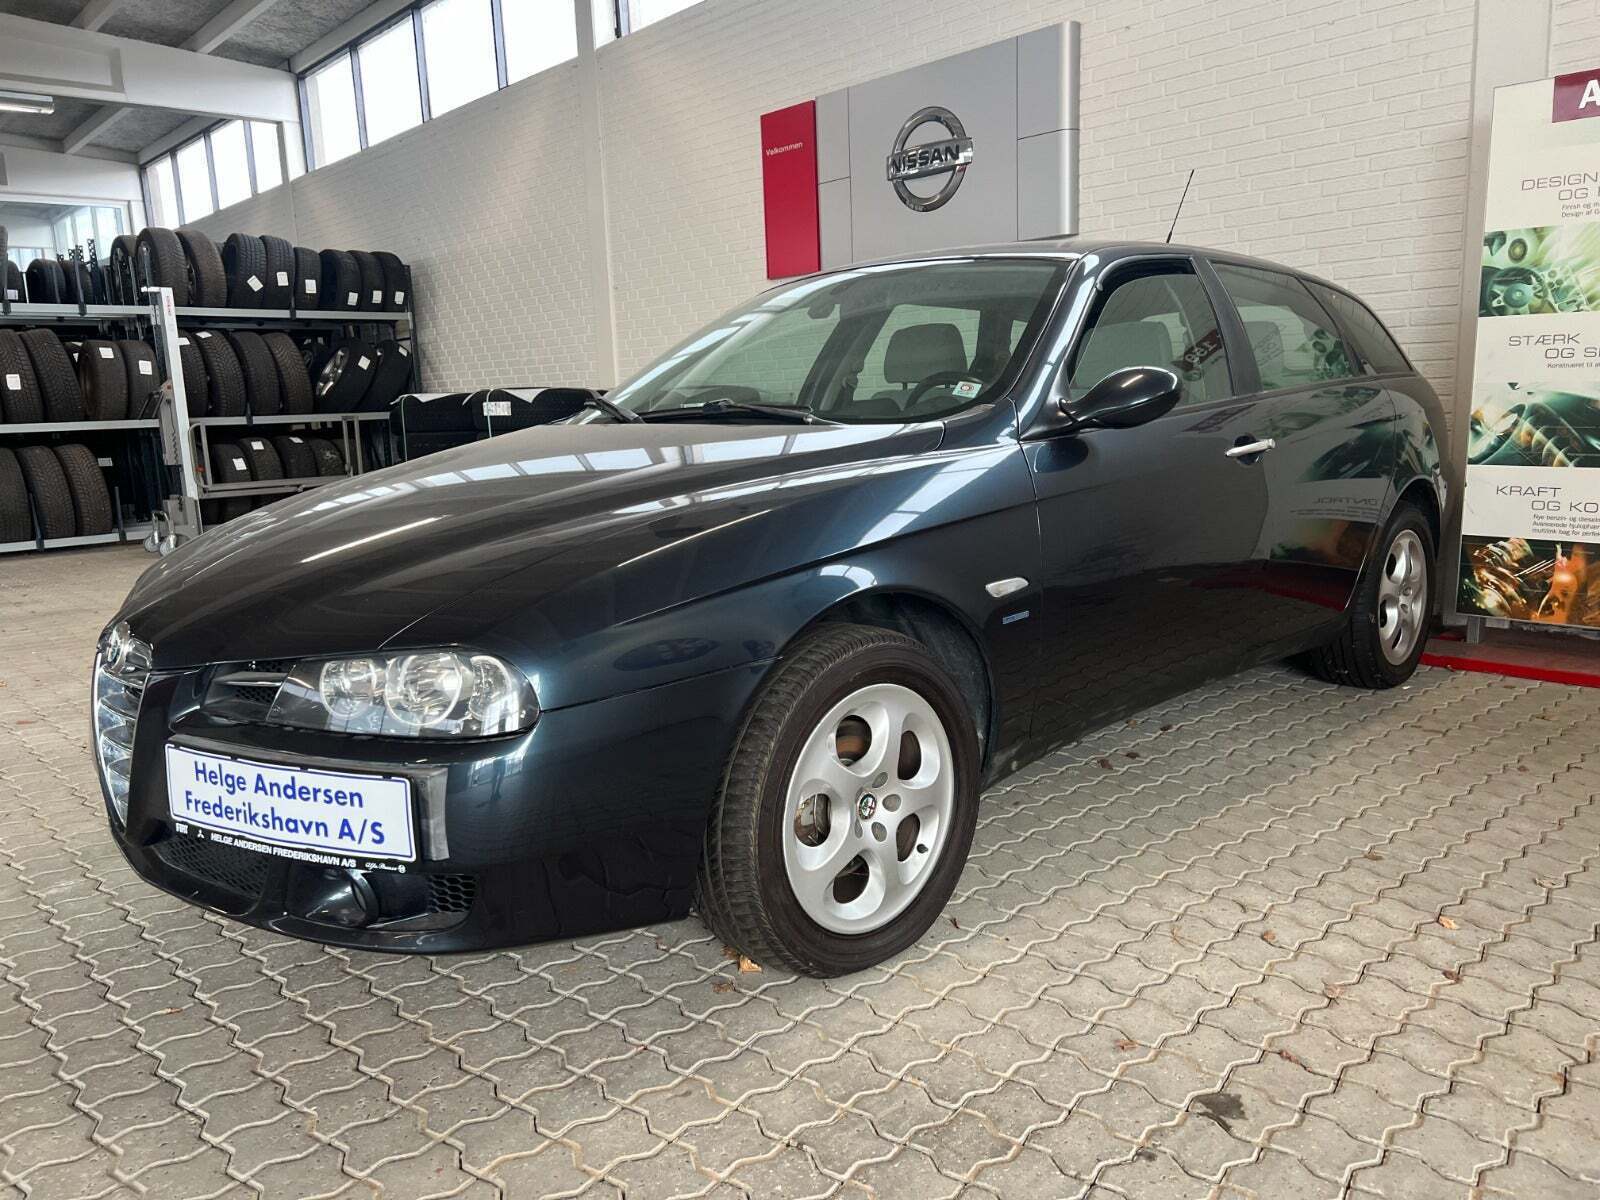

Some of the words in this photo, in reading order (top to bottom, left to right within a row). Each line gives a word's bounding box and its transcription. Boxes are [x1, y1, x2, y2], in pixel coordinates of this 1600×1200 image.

[765, 142, 803, 156] Velkommen
[893, 144, 960, 172] NISSAN
[1521, 172, 1598, 190] DESIGN
[1558, 187, 1589, 201] OG
[1508, 333, 1581, 346] STÆRK
[1545, 347, 1575, 359] OG
[1496, 485, 1562, 498] KRAFT
[1531, 500, 1560, 511] OG
[194, 761, 247, 796] Helge
[253, 773, 364, 809] Andersen
[185, 790, 329, 838] Frederikshavn
[338, 818, 386, 845] A/S
[210, 832, 233, 846] HELGE
[233, 838, 272, 855] ANDERSEN
[272, 846, 340, 866] FREDERIKSHAVN
[341, 858, 357, 868] A/S
